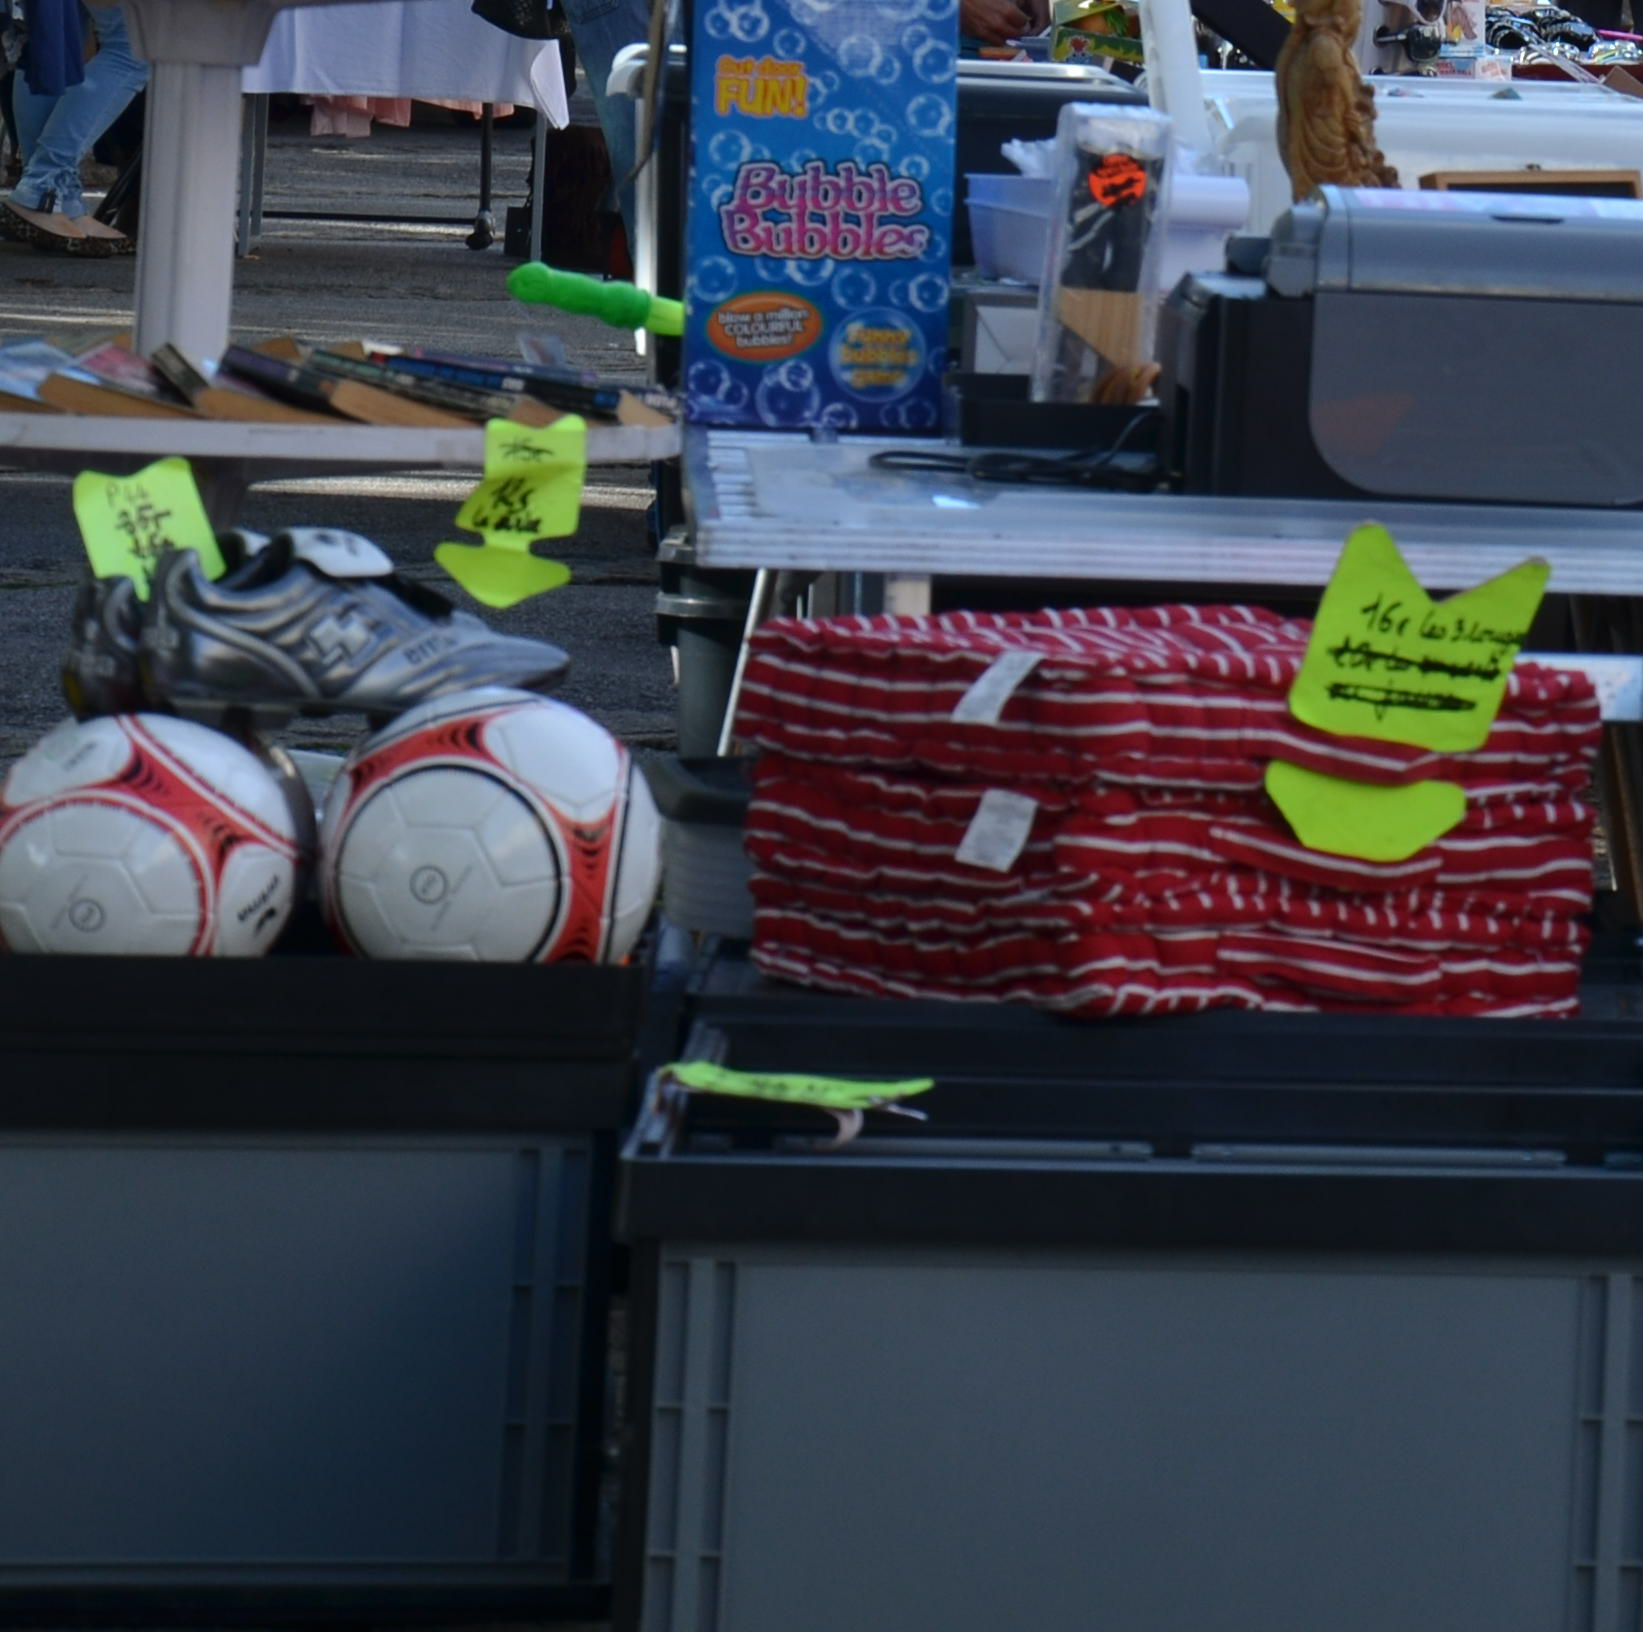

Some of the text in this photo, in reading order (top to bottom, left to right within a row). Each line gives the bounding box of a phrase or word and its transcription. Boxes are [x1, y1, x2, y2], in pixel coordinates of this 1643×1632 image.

[714, 75, 808, 118] FUN!
[732, 160, 923, 216] Bubble
[719, 204, 931, 262] Bubbles
[724, 318, 804, 337] COLOURFUL
